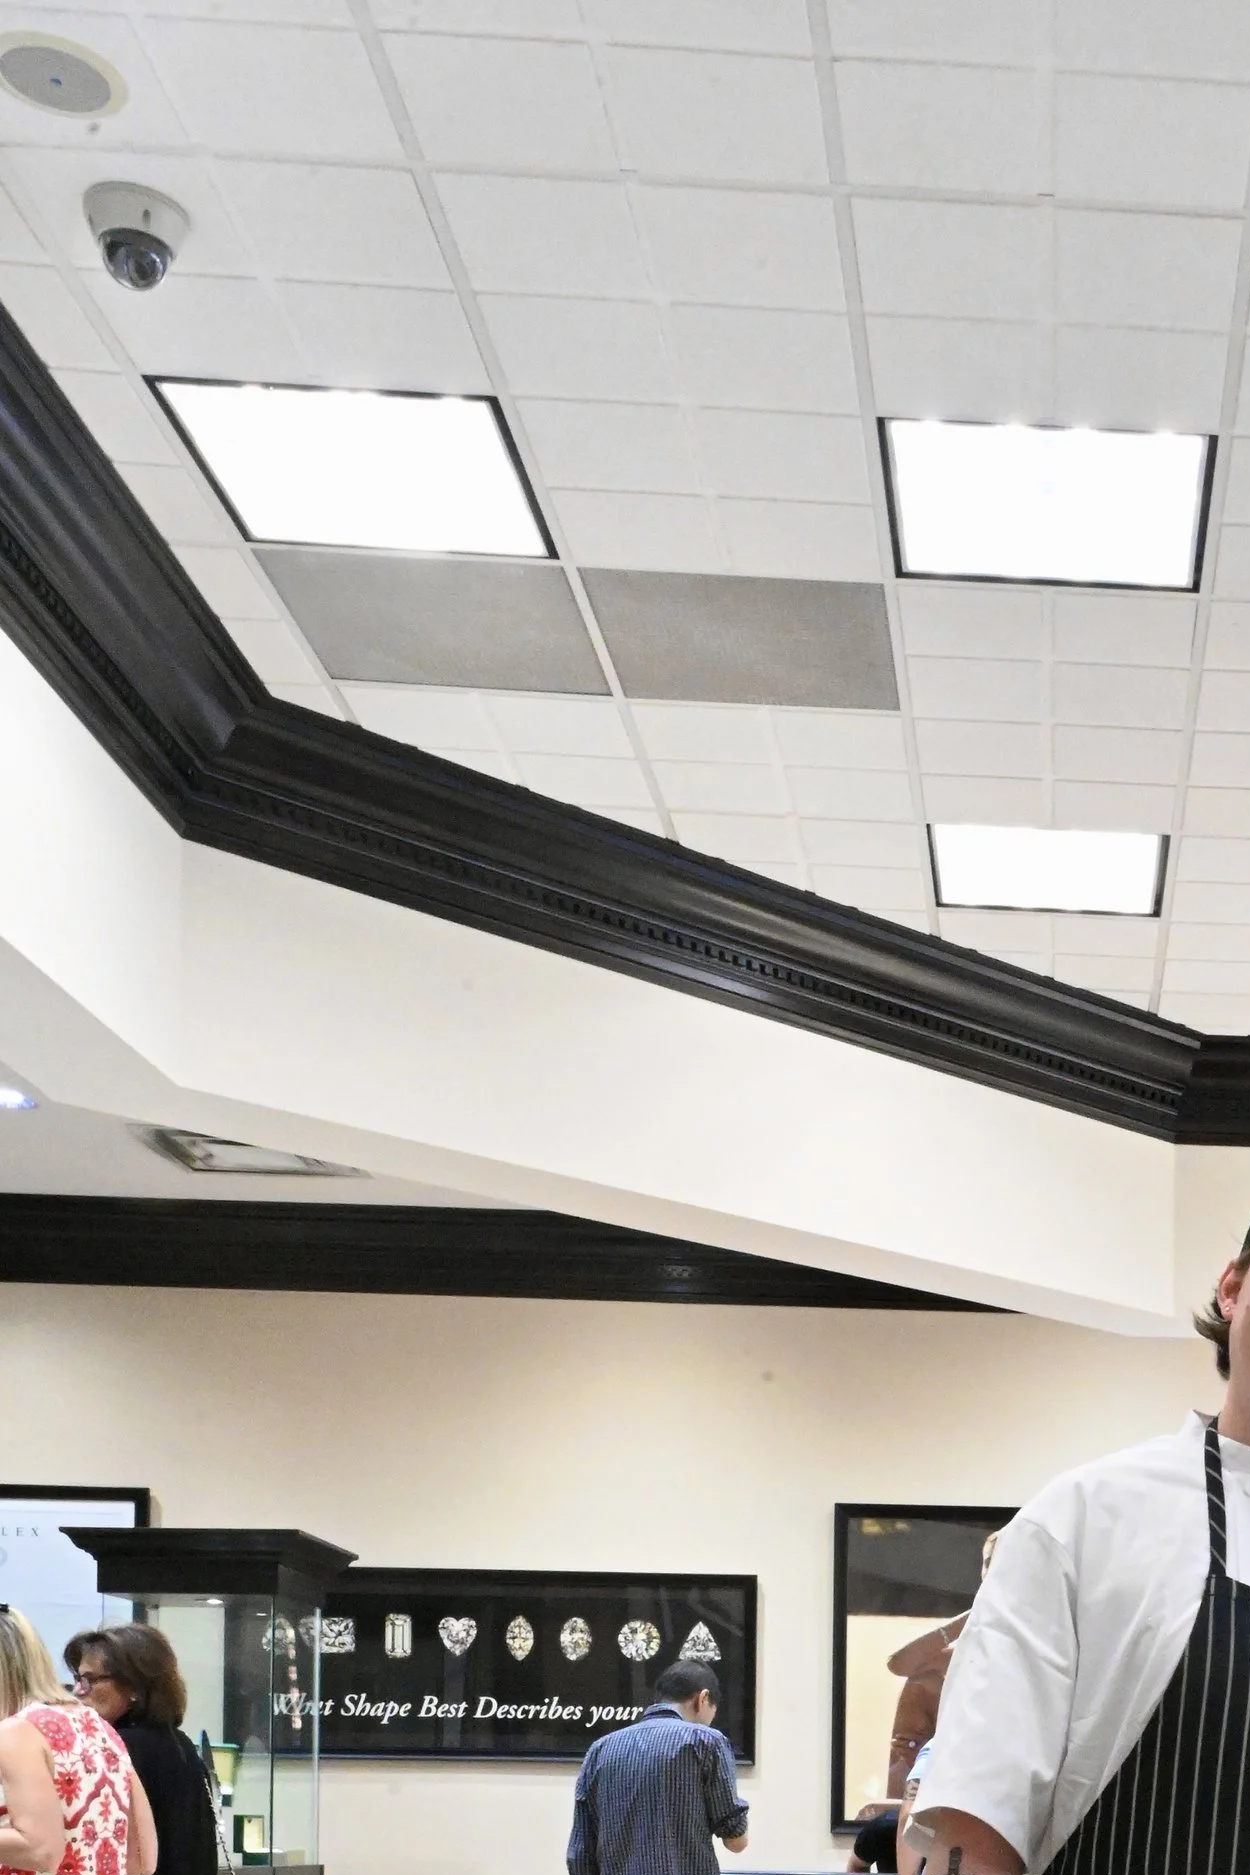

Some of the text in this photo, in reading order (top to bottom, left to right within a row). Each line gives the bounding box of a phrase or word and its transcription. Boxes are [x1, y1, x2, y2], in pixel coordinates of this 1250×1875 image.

[340, 1692, 412, 1725] Shape
[417, 1695, 469, 1718] Best
[473, 1696, 583, 1720] Describes
[585, 1705, 644, 1728] your
